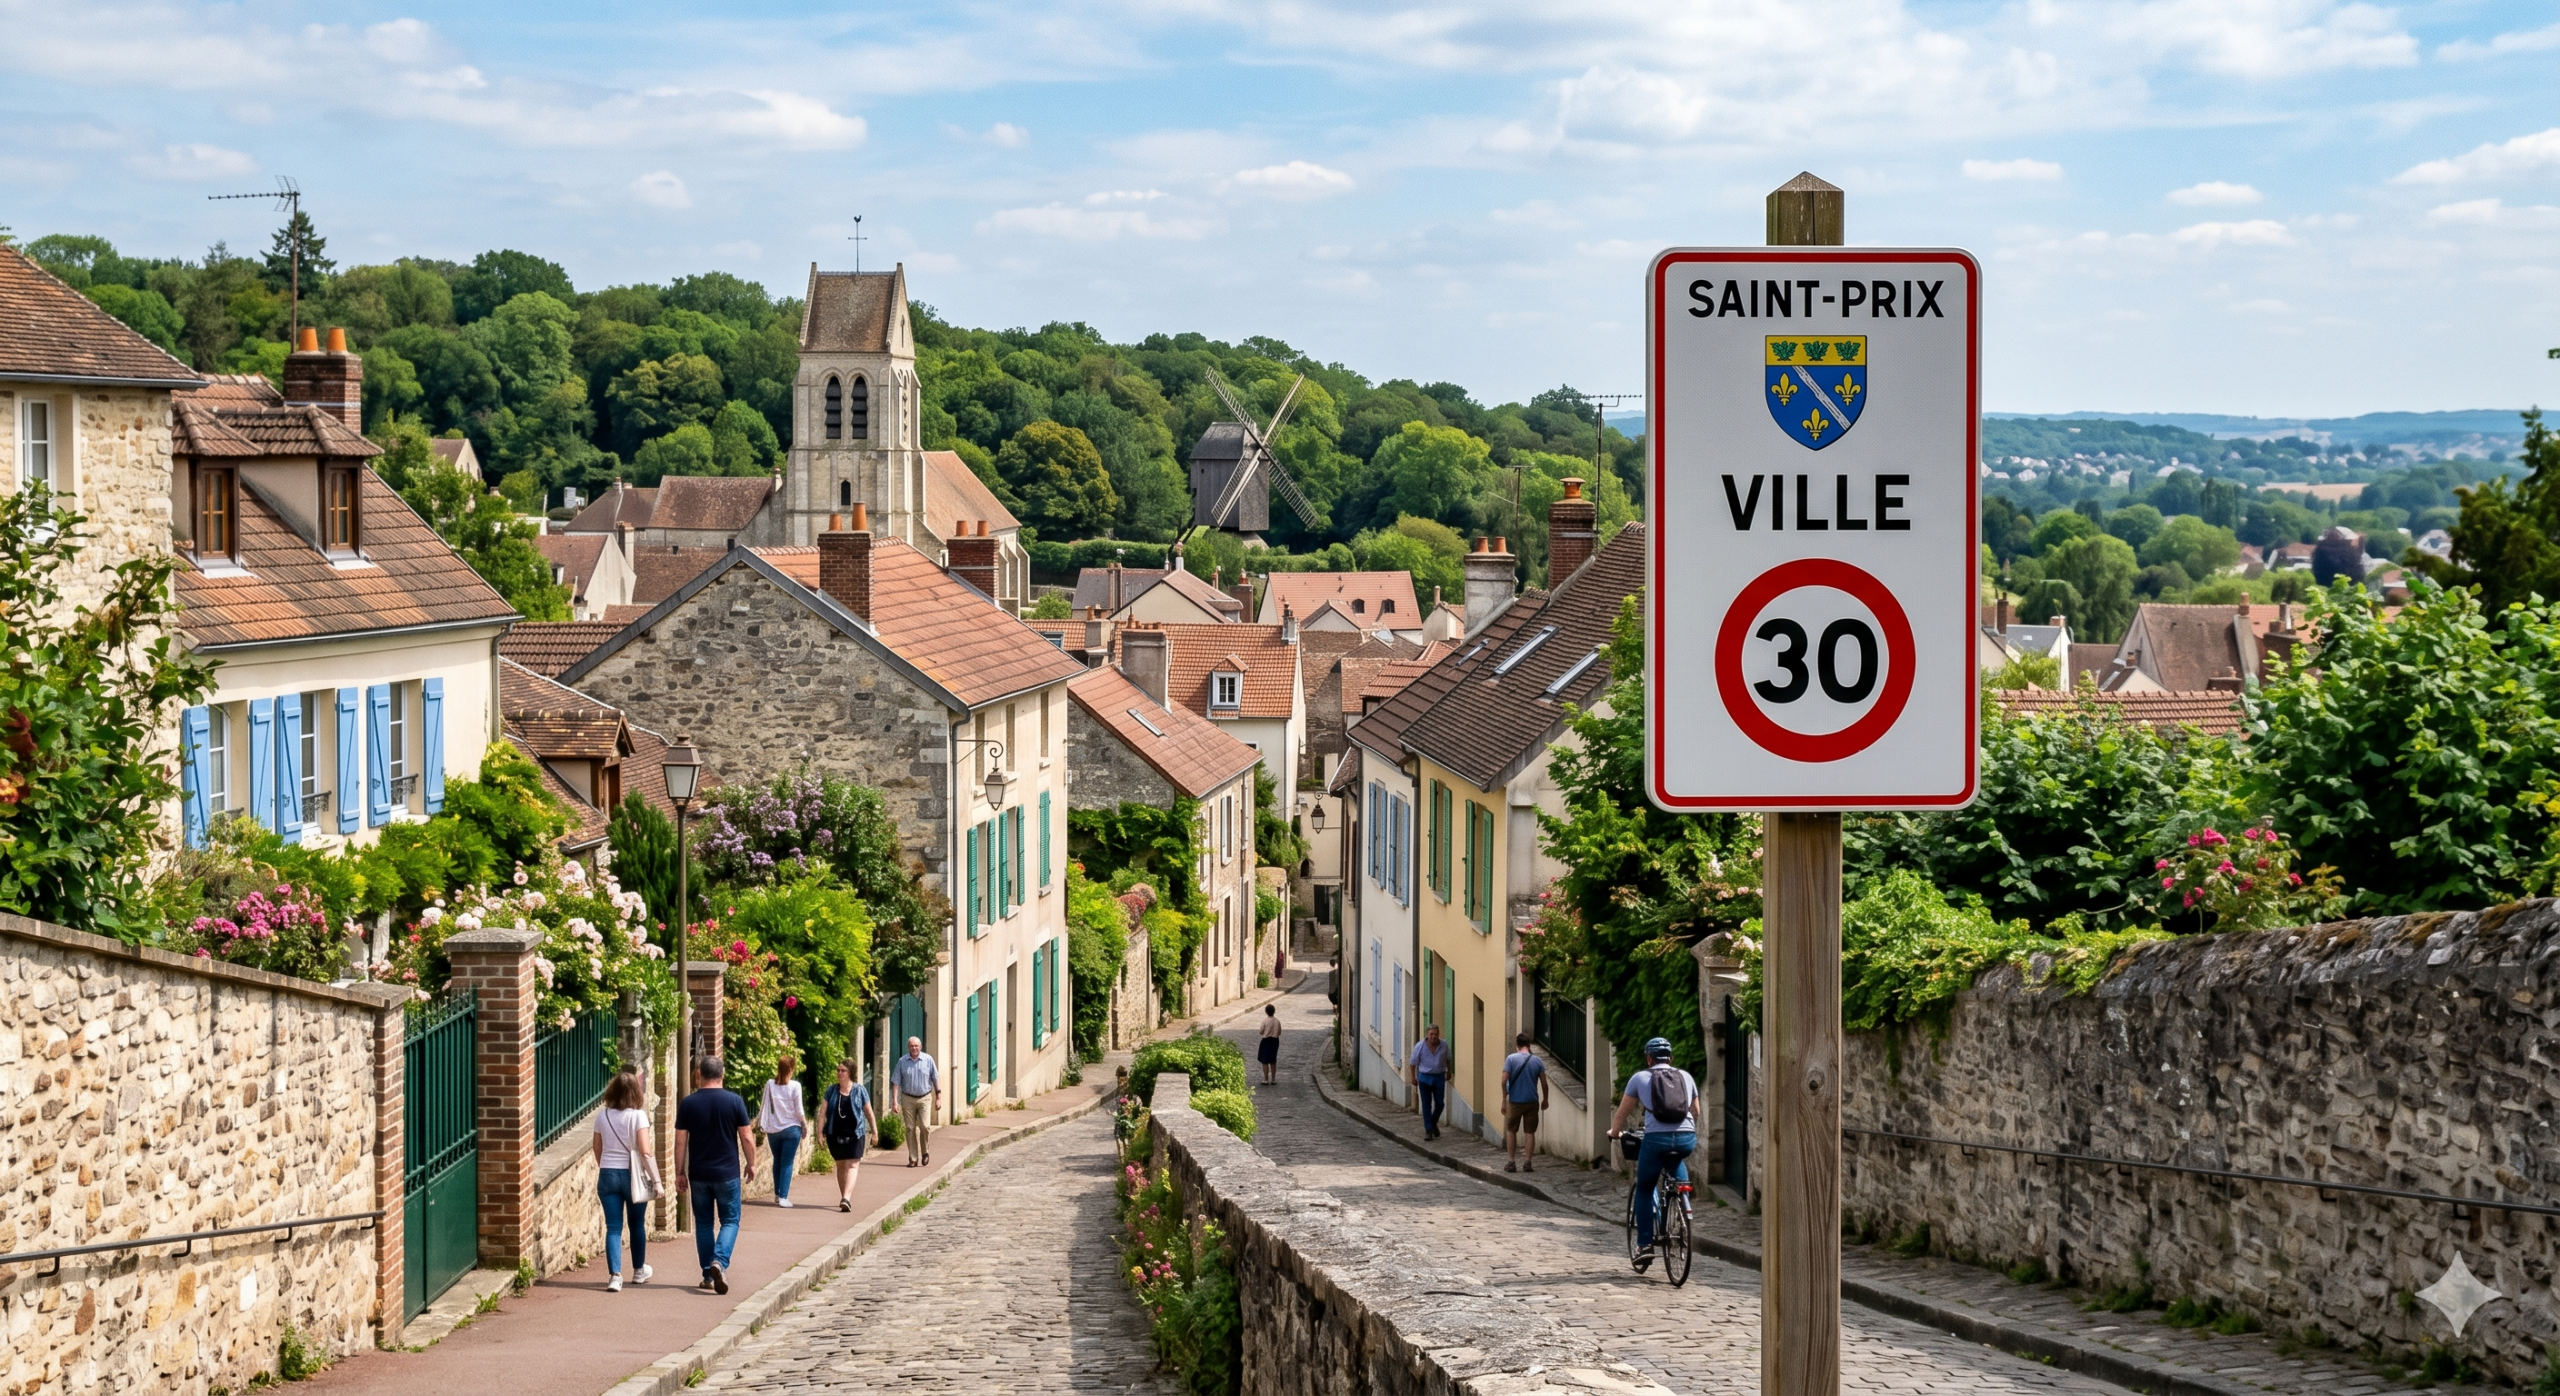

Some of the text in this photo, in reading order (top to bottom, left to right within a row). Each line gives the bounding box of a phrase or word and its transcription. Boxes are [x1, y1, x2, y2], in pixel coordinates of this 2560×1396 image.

[1687, 279, 1945, 319] SAINT-PRIX
[1721, 474, 1911, 531] VILLE
[1753, 617, 1879, 704] 30
